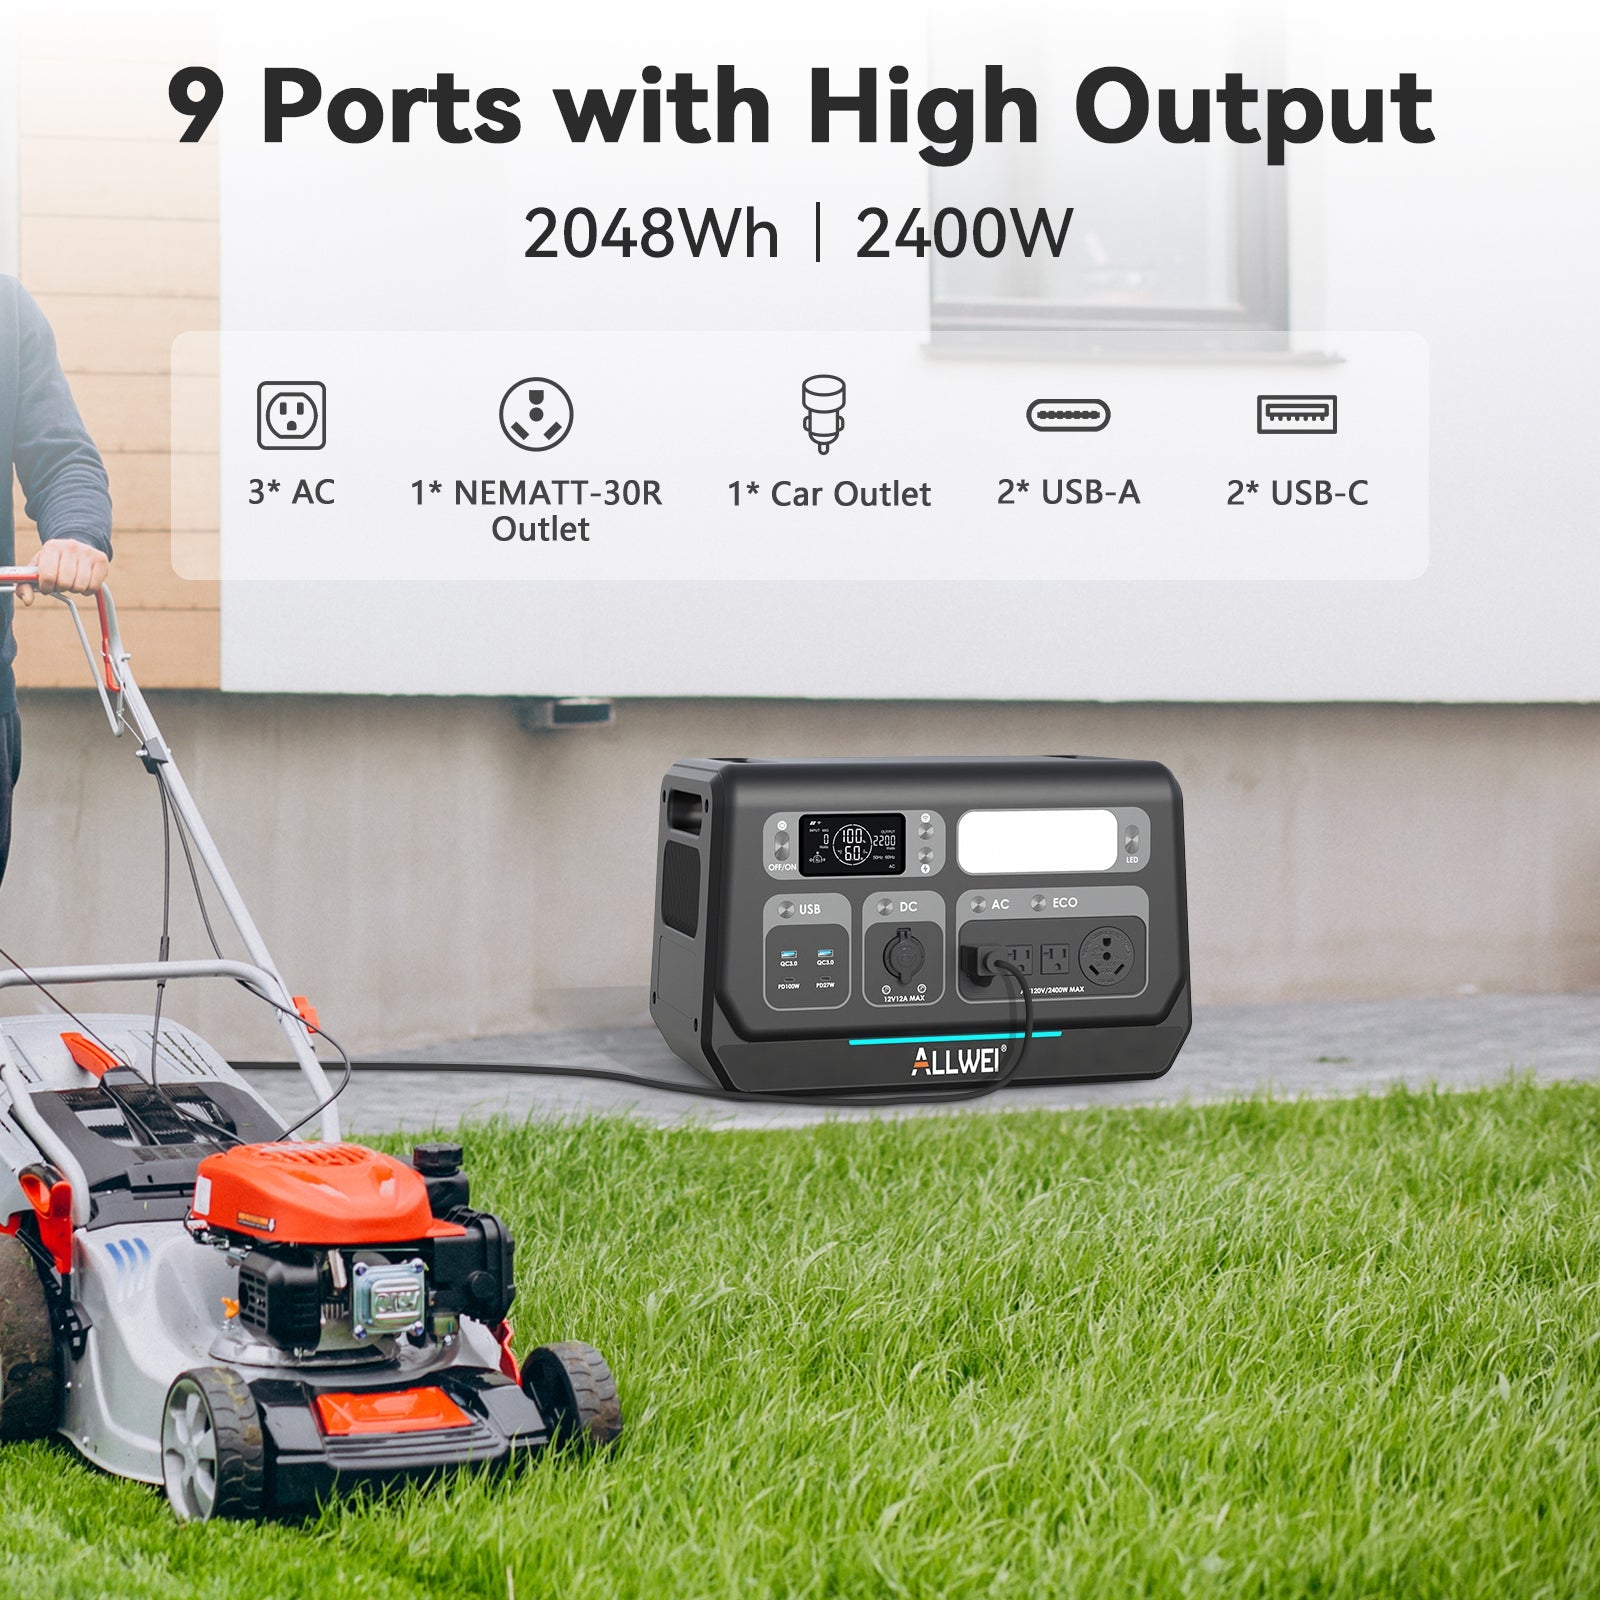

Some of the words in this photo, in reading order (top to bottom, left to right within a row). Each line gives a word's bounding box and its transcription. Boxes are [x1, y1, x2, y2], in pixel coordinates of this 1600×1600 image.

[873, 834, 896, 847] 2200
[1126, 856, 1139, 864] LED
[768, 863, 797, 872] OFF/ON
[899, 901, 918, 912] DC
[991, 898, 1010, 910] AC
[1052, 897, 1079, 908] ECO
[799, 903, 821, 915] USB
[1069, 985, 1085, 993] MAX
[909, 994, 926, 1002] MAX
